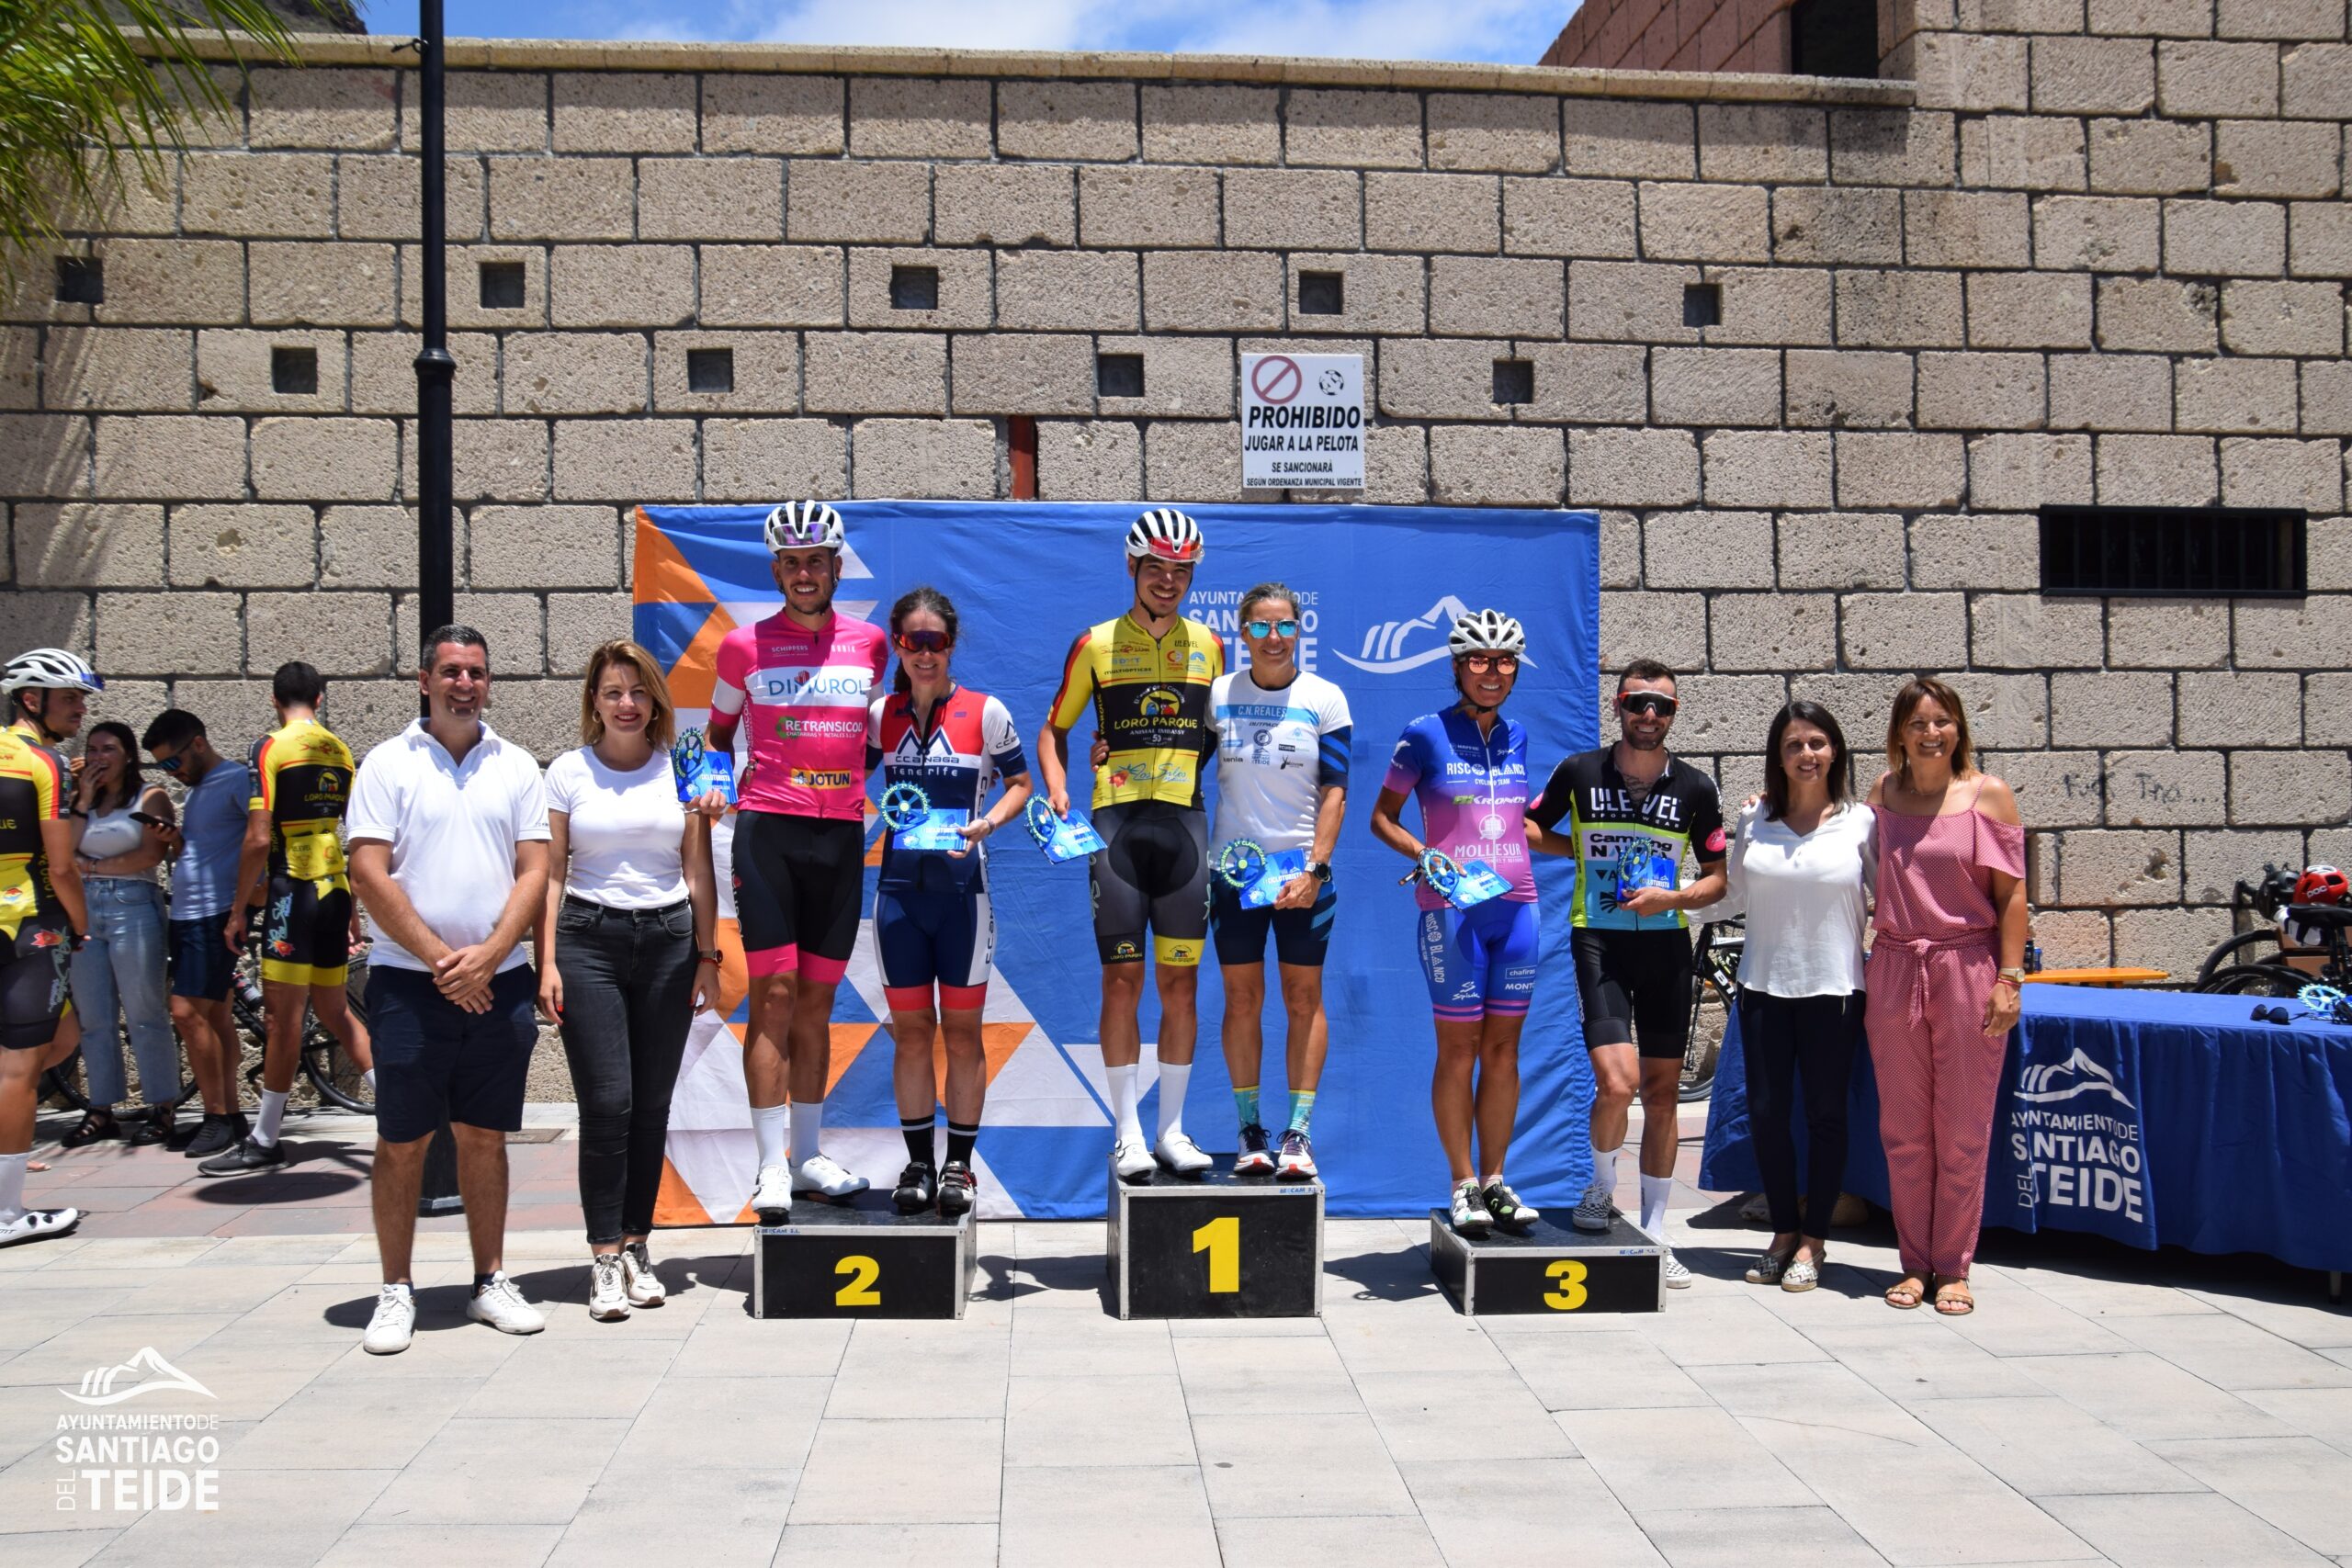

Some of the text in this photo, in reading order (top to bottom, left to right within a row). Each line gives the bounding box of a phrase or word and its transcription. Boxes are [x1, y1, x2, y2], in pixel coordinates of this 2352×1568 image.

[1248, 406, 1361, 429] PROHIBIDO
[1245, 435, 1358, 451] JUGAR A LA PELOTA
[1272, 462, 1281, 472] SE
[1268, 478, 1303, 486] ORDENANZA
[1305, 478, 1335, 486] MUNICIPAL
[1337, 478, 1362, 486] VIGENTE
[786, 720, 863, 732] RETRANSICOD
[1114, 716, 1198, 730] LORO PARQUE
[809, 773, 850, 785] JOTUN
[1590, 787, 1680, 822] ULEVEL
[1454, 843, 1521, 858] MOLLESUR
[2011, 1132, 2141, 1174] SNTIAGO
[1193, 1217, 1239, 1293] 1
[834, 1255, 881, 1306] 2
[1544, 1259, 1588, 1310] 3
